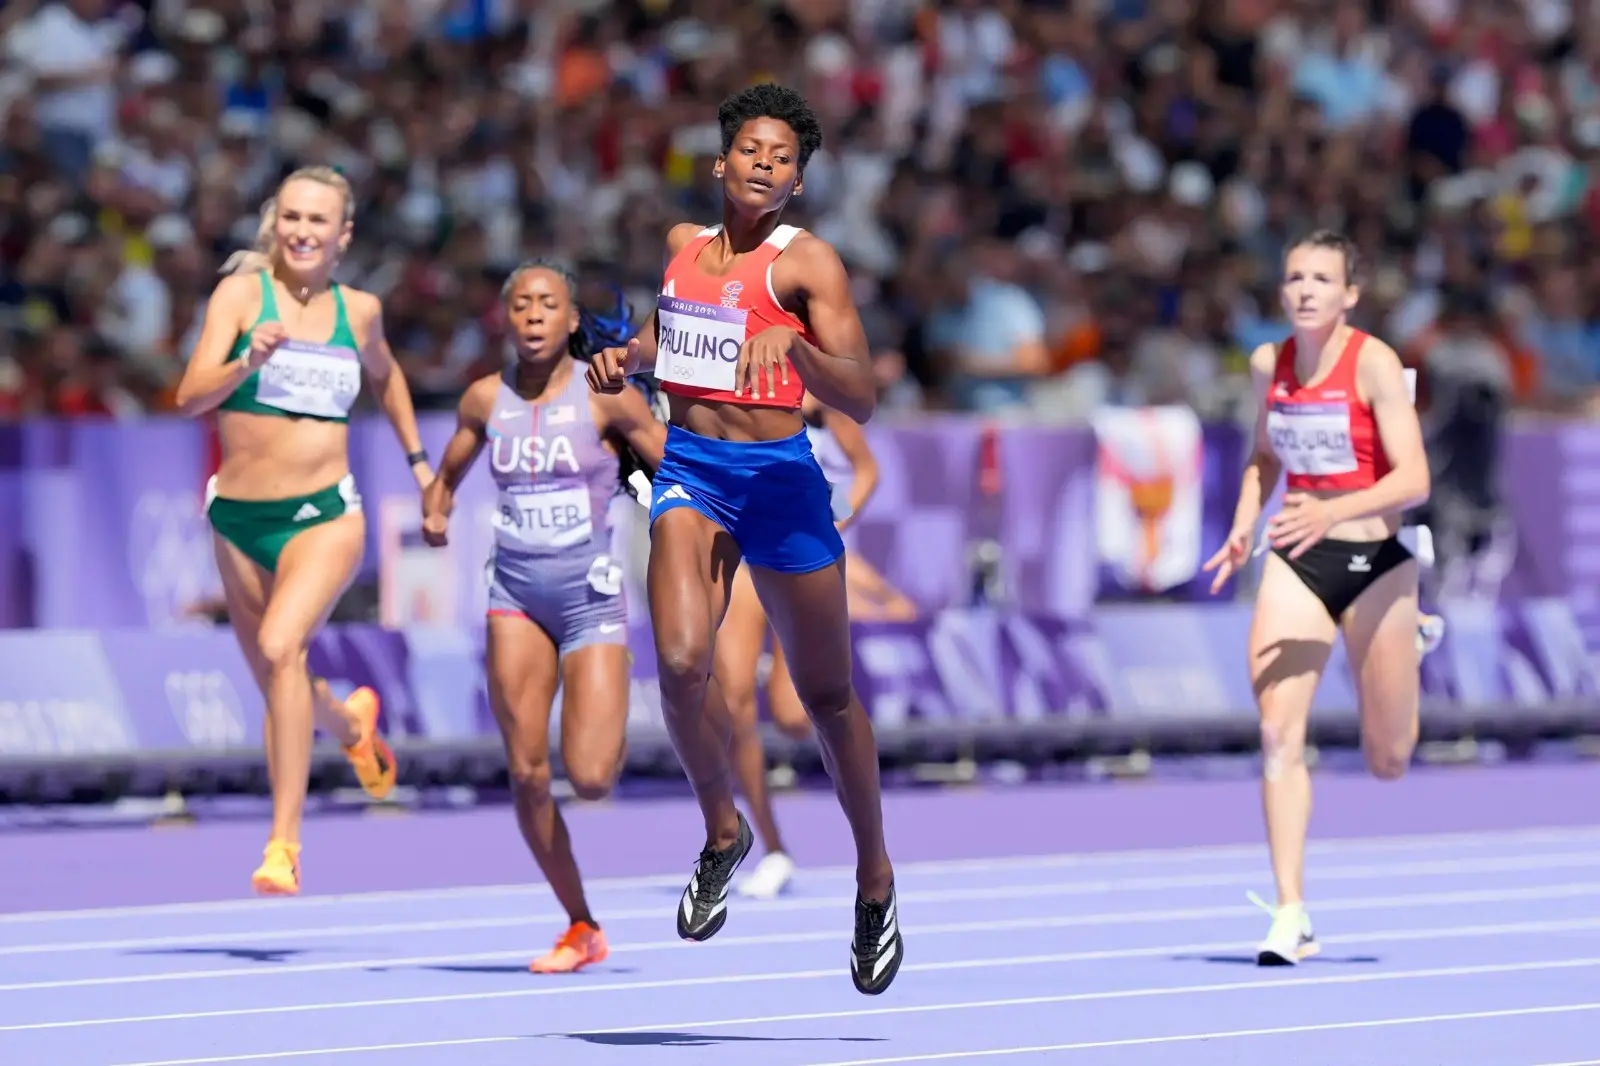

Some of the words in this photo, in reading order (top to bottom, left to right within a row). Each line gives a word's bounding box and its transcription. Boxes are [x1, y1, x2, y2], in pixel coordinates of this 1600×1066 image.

[671, 300, 692, 312] PARIS
[694, 305, 717, 316] 2024
[660, 325, 740, 363] PAULINO
[492, 434, 580, 474] USA
[501, 504, 580, 530] BUTLER
